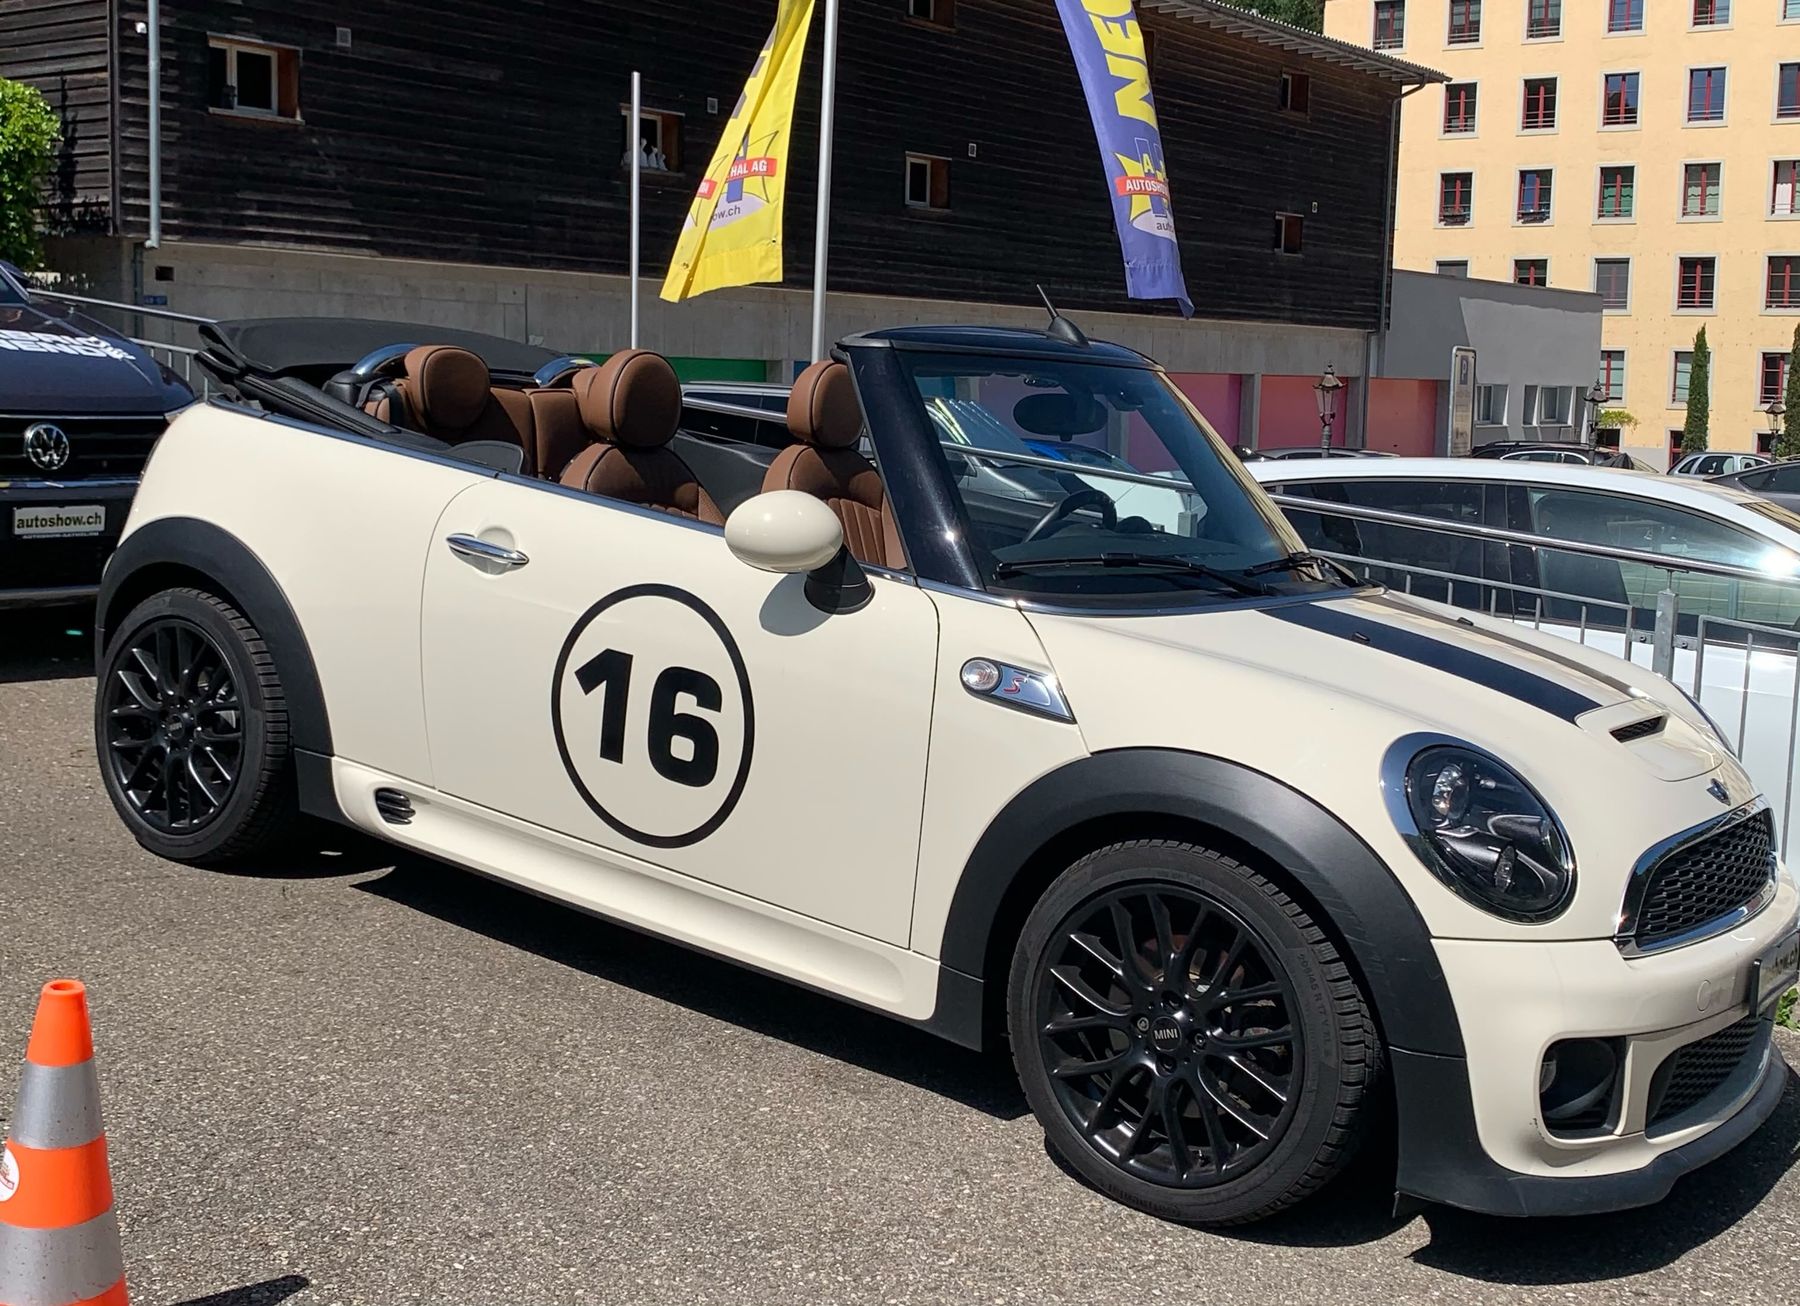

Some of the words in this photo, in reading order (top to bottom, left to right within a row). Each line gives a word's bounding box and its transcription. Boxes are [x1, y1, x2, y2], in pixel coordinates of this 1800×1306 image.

[750, 160, 768, 173] AG
[16, 512, 102, 529] autoshow.ch
[574, 648, 722, 787] 16
[1153, 1028, 1179, 1040] MINI
